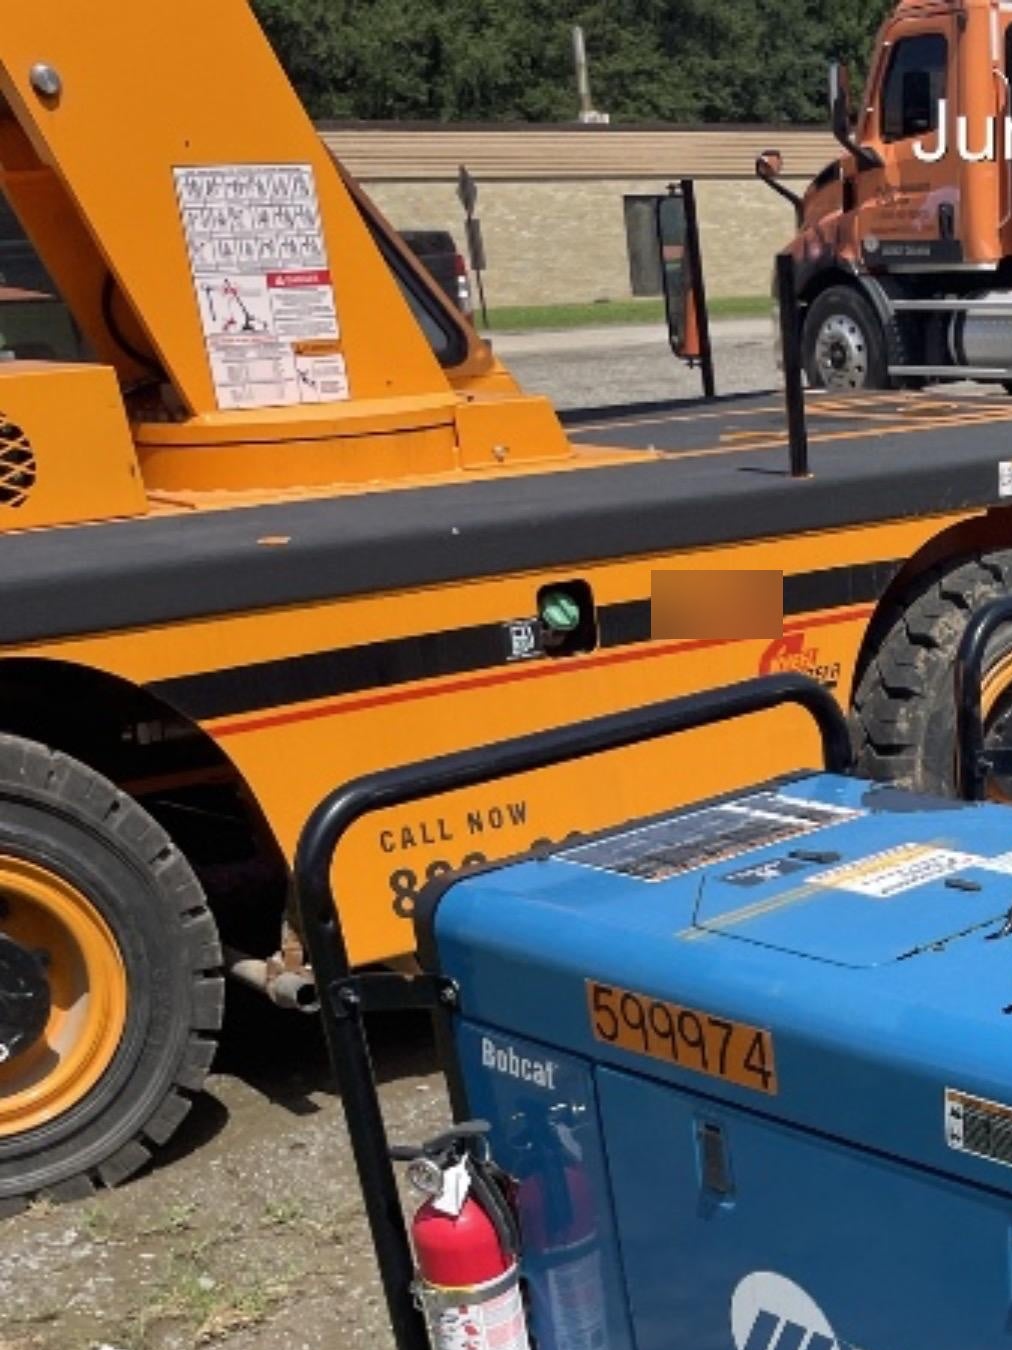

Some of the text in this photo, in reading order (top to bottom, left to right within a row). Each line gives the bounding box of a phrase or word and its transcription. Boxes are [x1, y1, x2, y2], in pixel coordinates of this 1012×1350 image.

[379, 800, 527, 853] CALL NOW
[481, 1036, 557, 1091] Bobcat
[592, 984, 772, 1089] 599974
